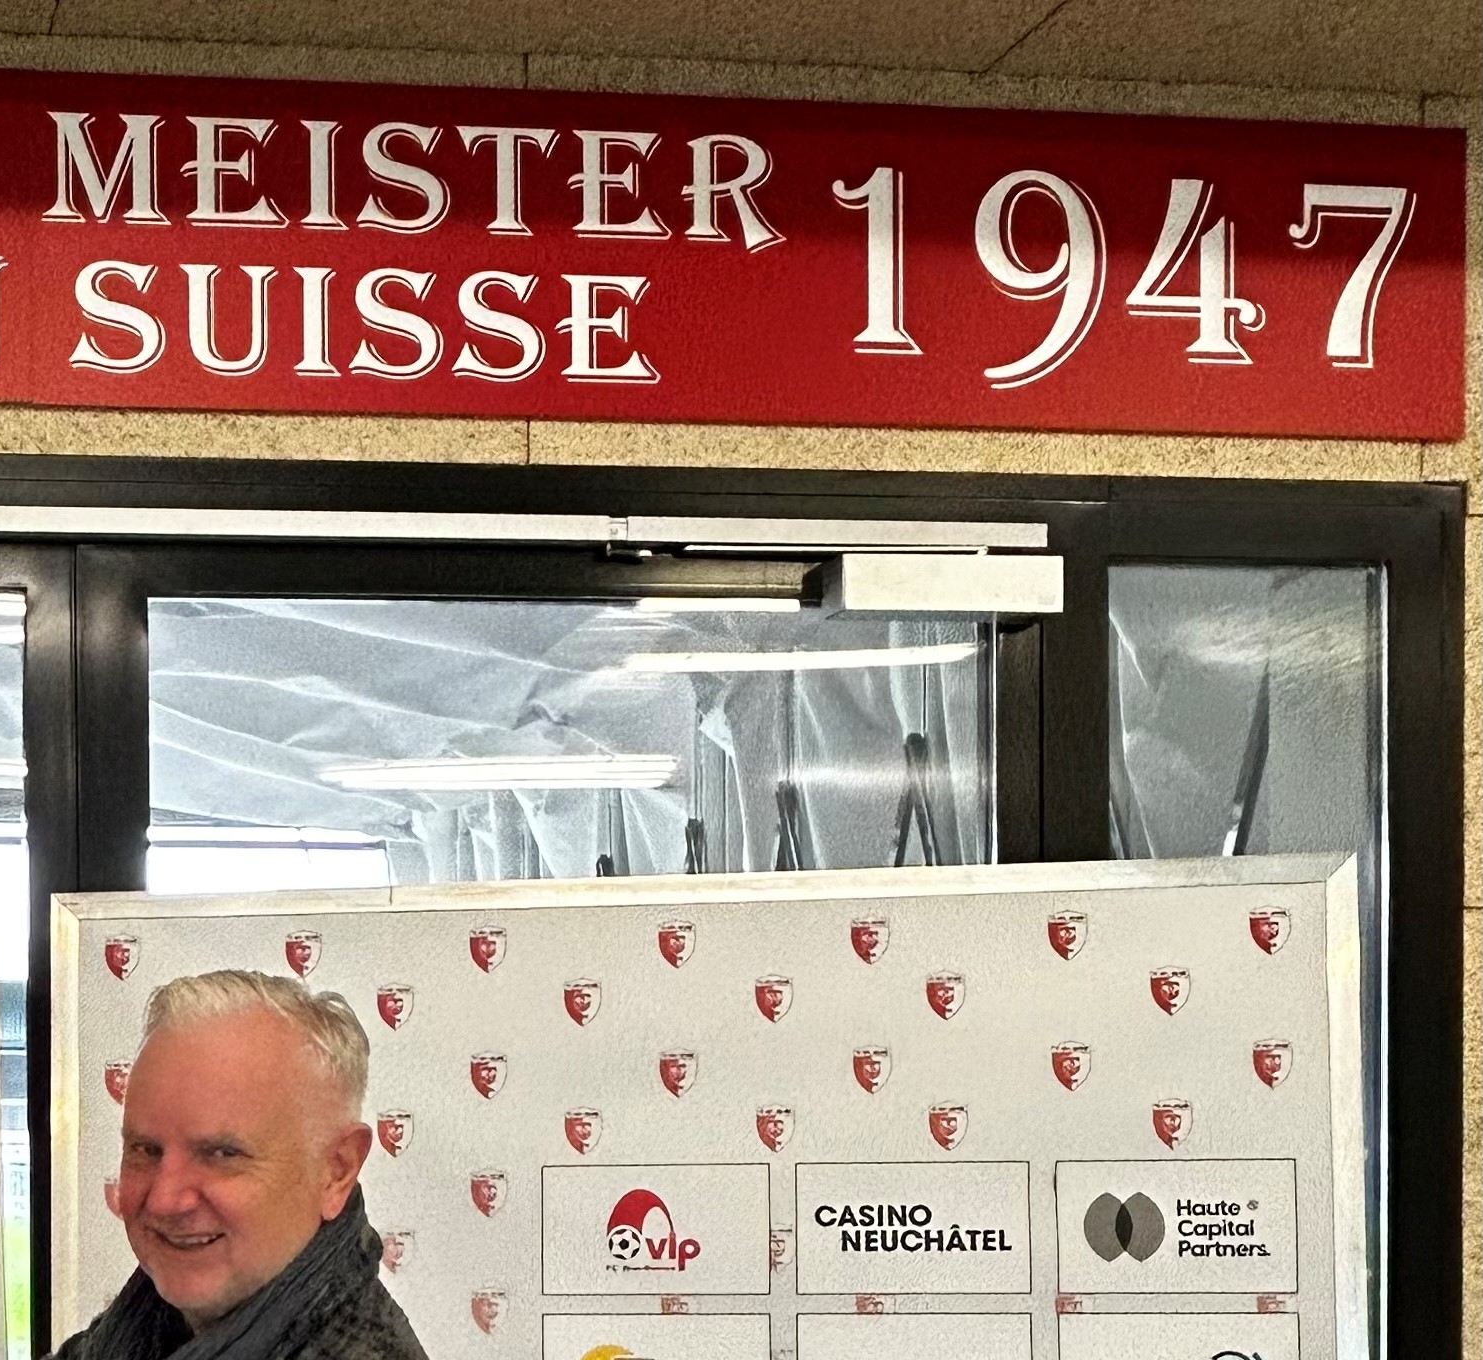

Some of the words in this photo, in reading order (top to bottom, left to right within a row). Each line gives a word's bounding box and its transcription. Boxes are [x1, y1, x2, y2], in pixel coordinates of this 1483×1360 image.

[42, 111, 785, 253] MEISTER
[832, 167, 1416, 389] 1947
[69, 262, 660, 383] SUISSE
[814, 1205, 932, 1229] CASINO
[1177, 1199, 1240, 1216] Haute
[840, 1224, 1012, 1253] NEUCHÂTEL
[1178, 1219, 1254, 1240] Capital
